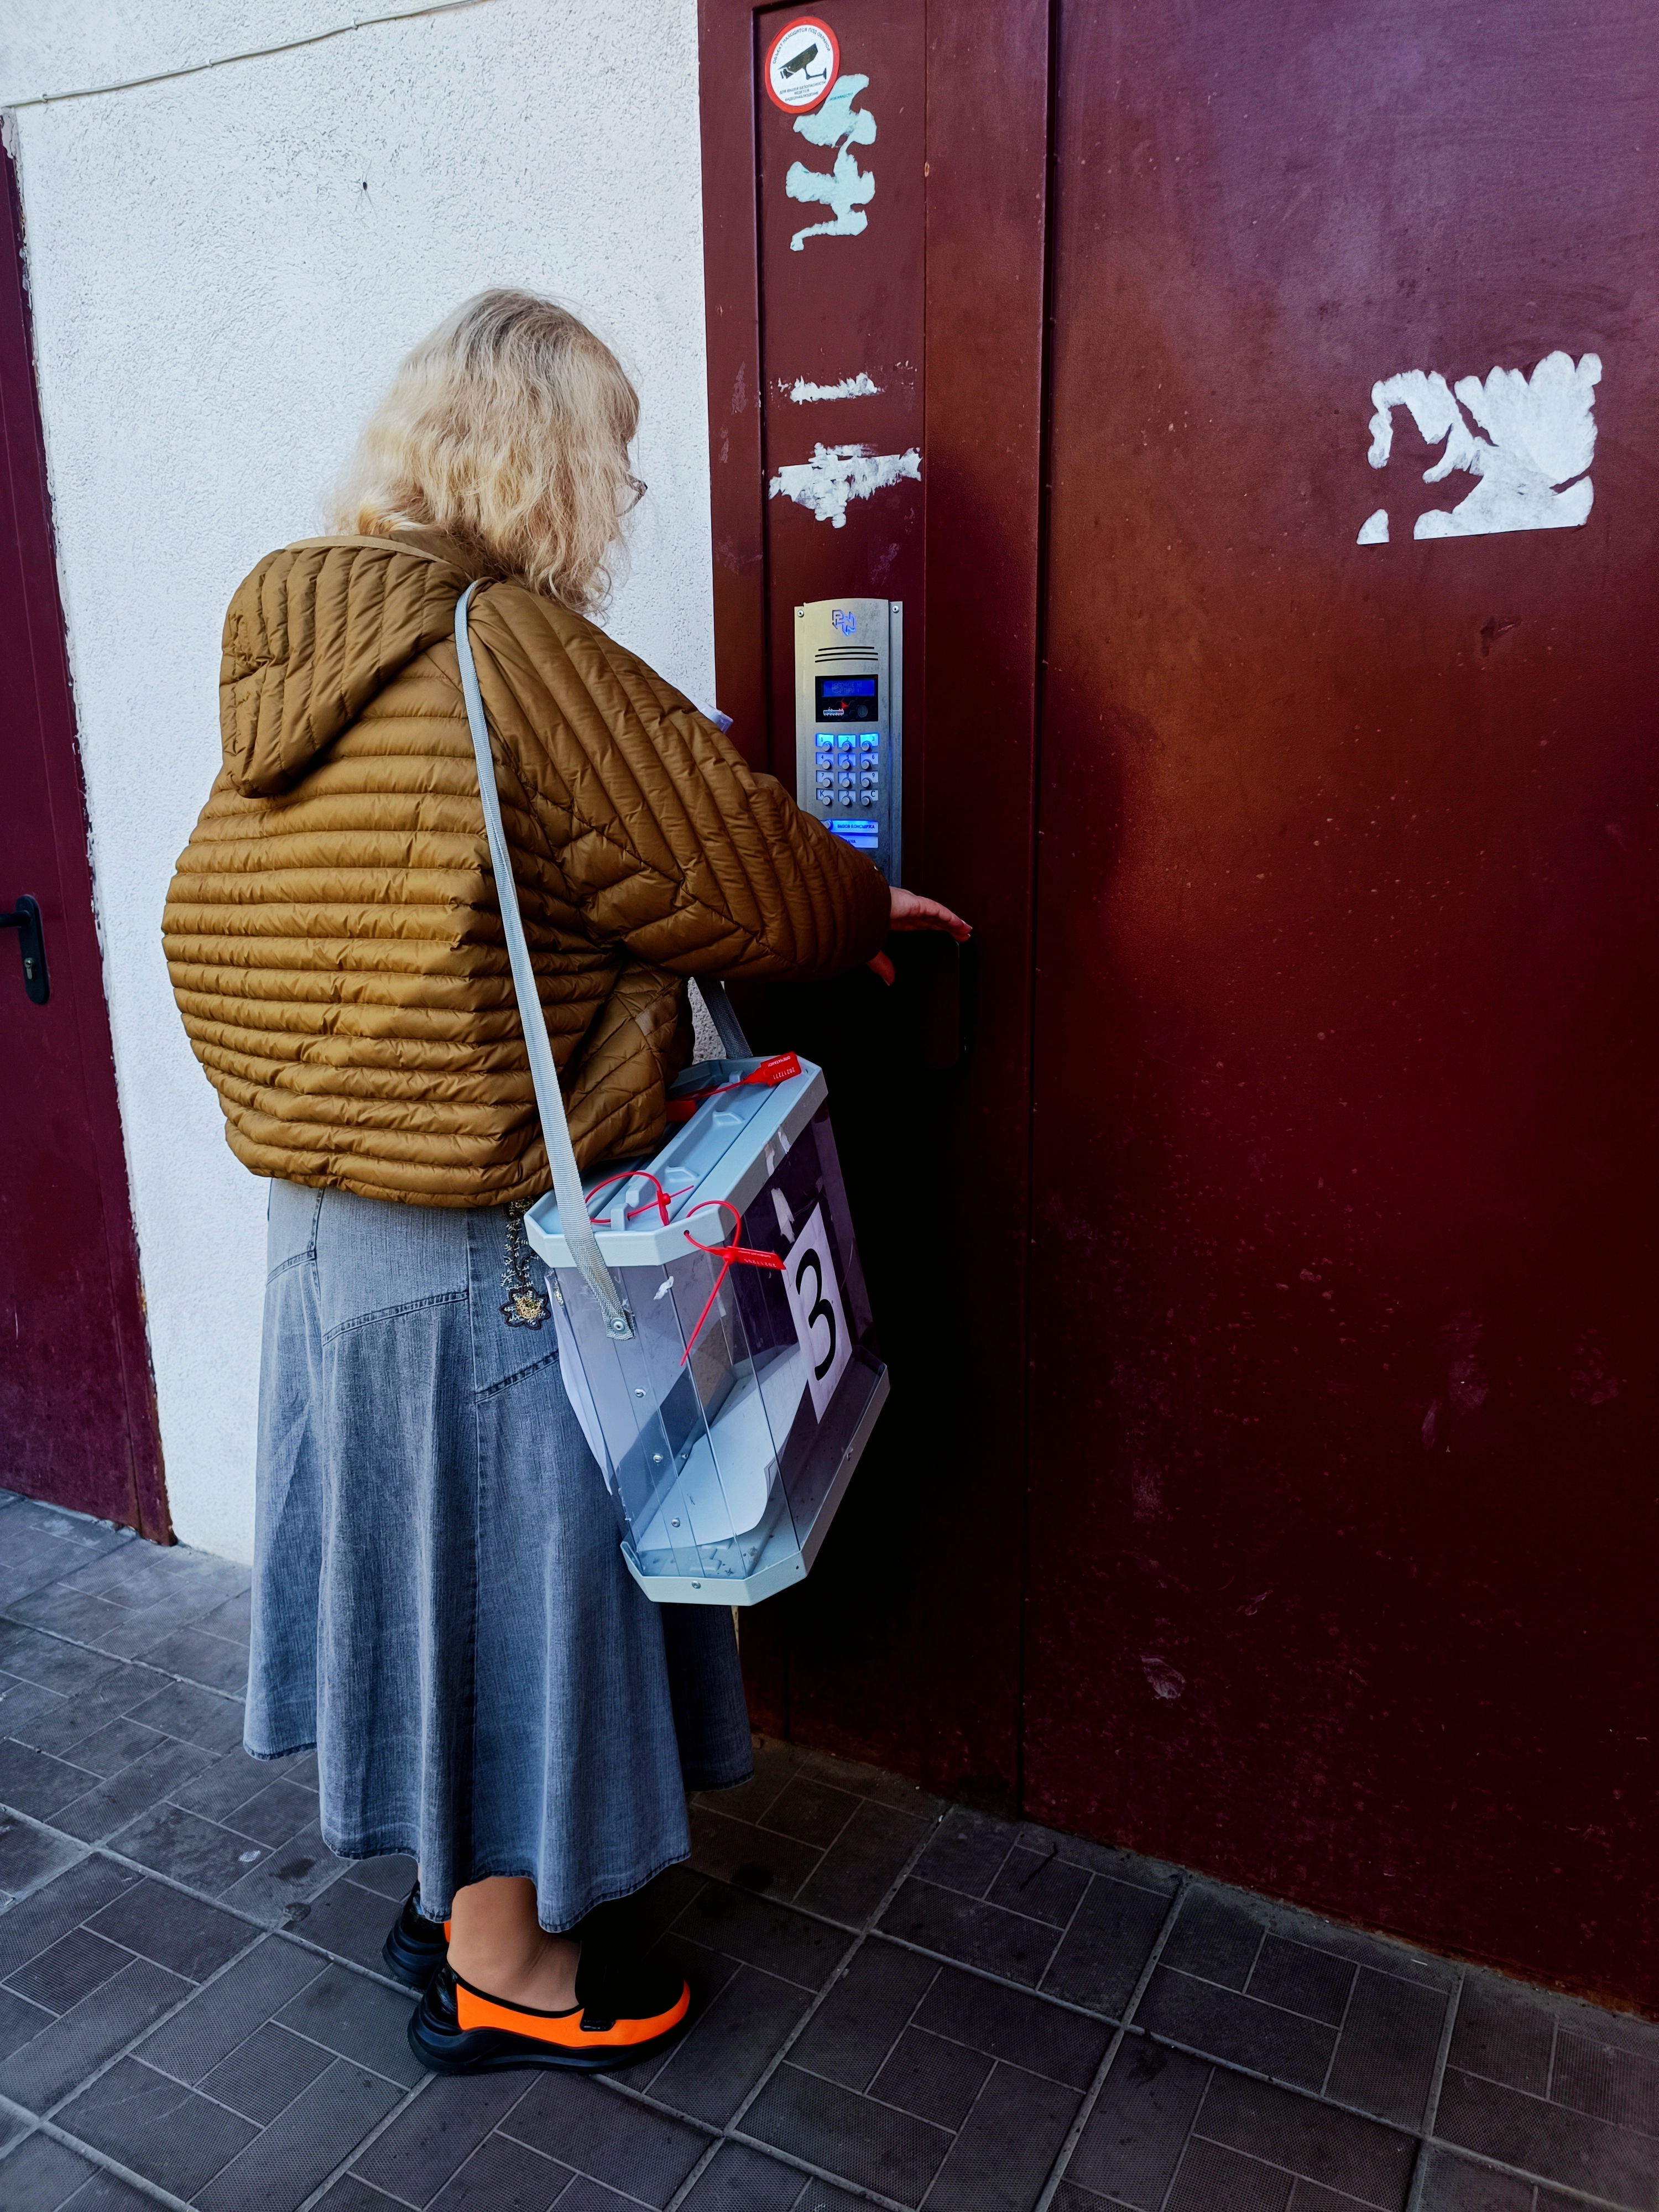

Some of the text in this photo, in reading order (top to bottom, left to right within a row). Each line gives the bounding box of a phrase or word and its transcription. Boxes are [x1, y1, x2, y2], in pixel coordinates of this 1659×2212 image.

[773, 44, 783, 64] ОБЪЕКТ
[782, 28, 807, 43] НАХОДИТСЯ
[817, 32, 831, 51] ОХРАНОЙ
[800, 81, 826, 90] БЕЗОПАСНОСТИ
[785, 91, 818, 101] ВИДЕОНАБЛЮДЕНИЕ
[773, 1067, 795, 1080] 20217271
[796, 1248, 837, 1381] 3
